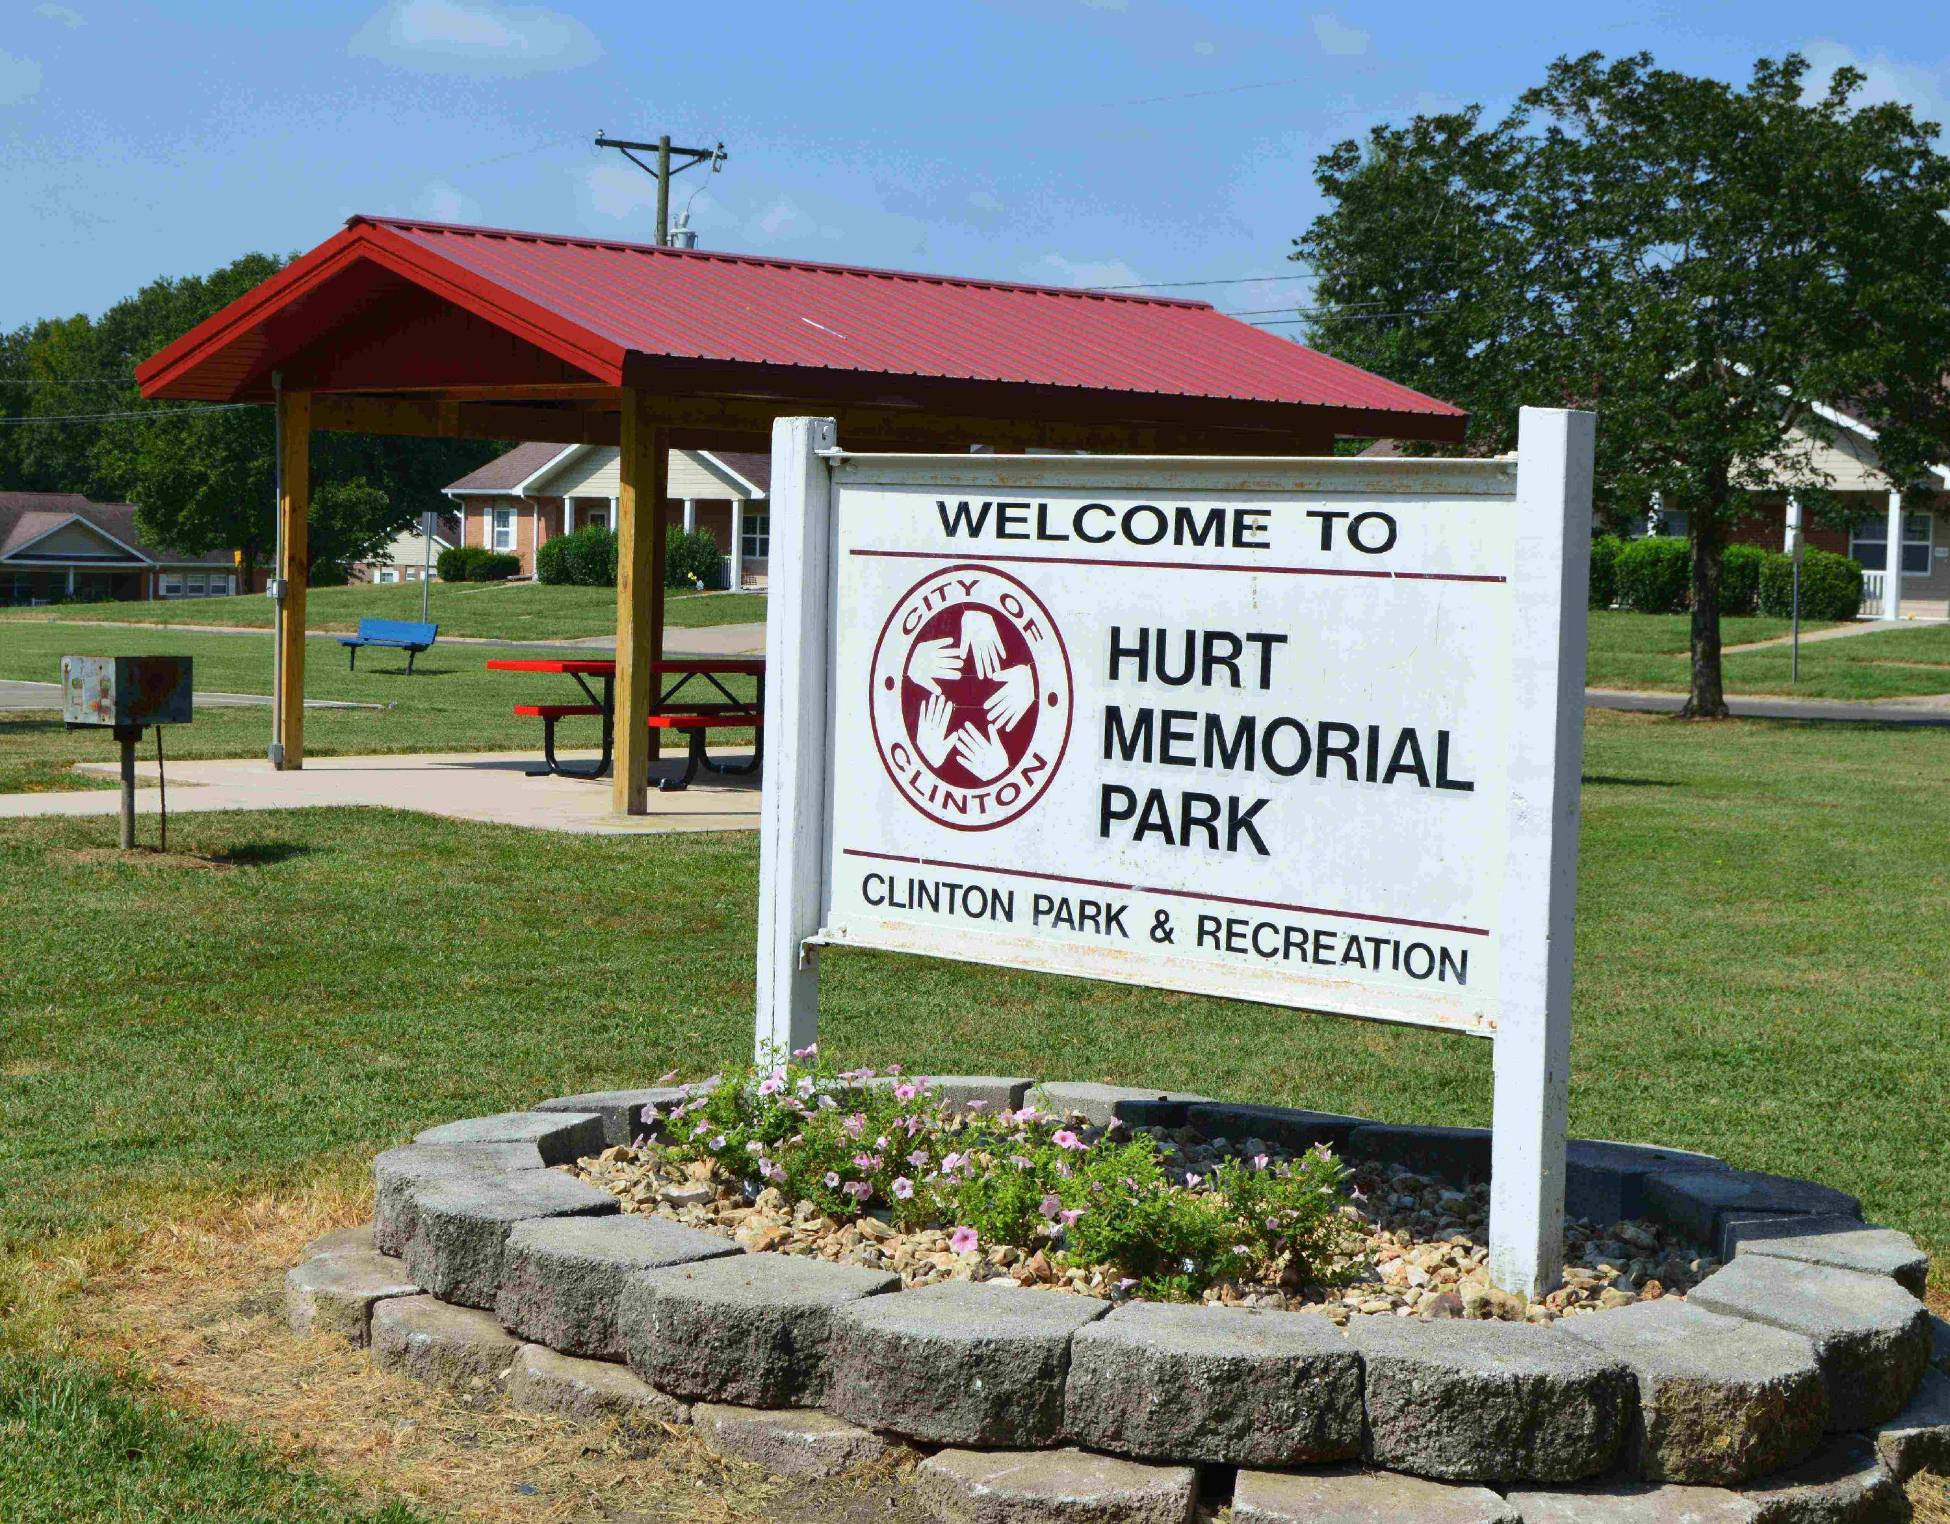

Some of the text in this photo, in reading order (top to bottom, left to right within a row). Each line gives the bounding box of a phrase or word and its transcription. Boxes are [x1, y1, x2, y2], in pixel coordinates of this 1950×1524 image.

[937, 500, 1398, 555] WELCOME TO
[902, 579, 1044, 643] CITY OF
[1109, 625, 1288, 690] HURT
[890, 742, 1048, 815] CLINTON
[1101, 705, 1475, 792] MEMORIAL
[1100, 783, 1271, 856] PARK
[862, 873, 1469, 985] CLINTON PARK & RECREATION
